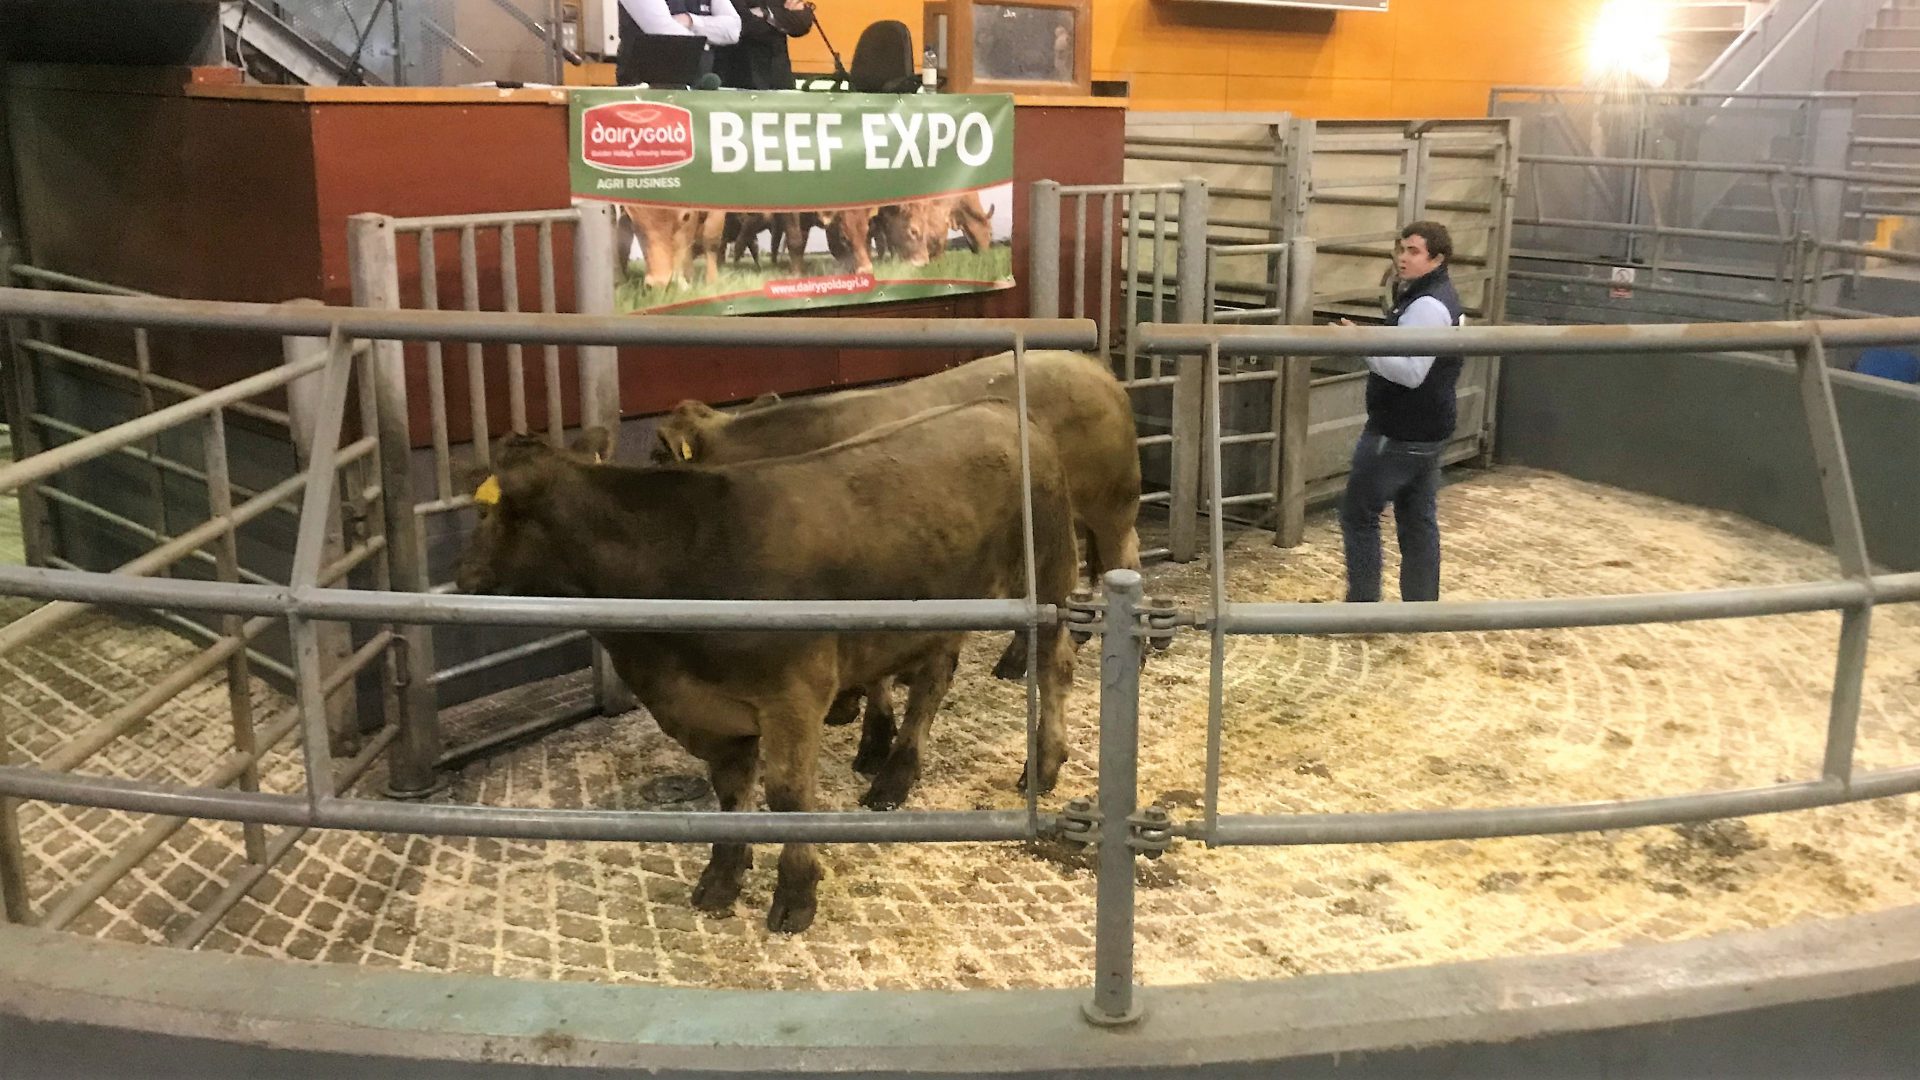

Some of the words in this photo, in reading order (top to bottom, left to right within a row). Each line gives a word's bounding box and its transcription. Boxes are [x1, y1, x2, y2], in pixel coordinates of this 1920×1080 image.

[591, 121, 686, 149] dairygold
[709, 111, 843, 172] BEEF
[861, 111, 994, 169] EXPO
[597, 178, 624, 189] AGRI
[626, 176, 681, 188] BUSINESS
[770, 276, 870, 294] www.dairygoldagri.ie
